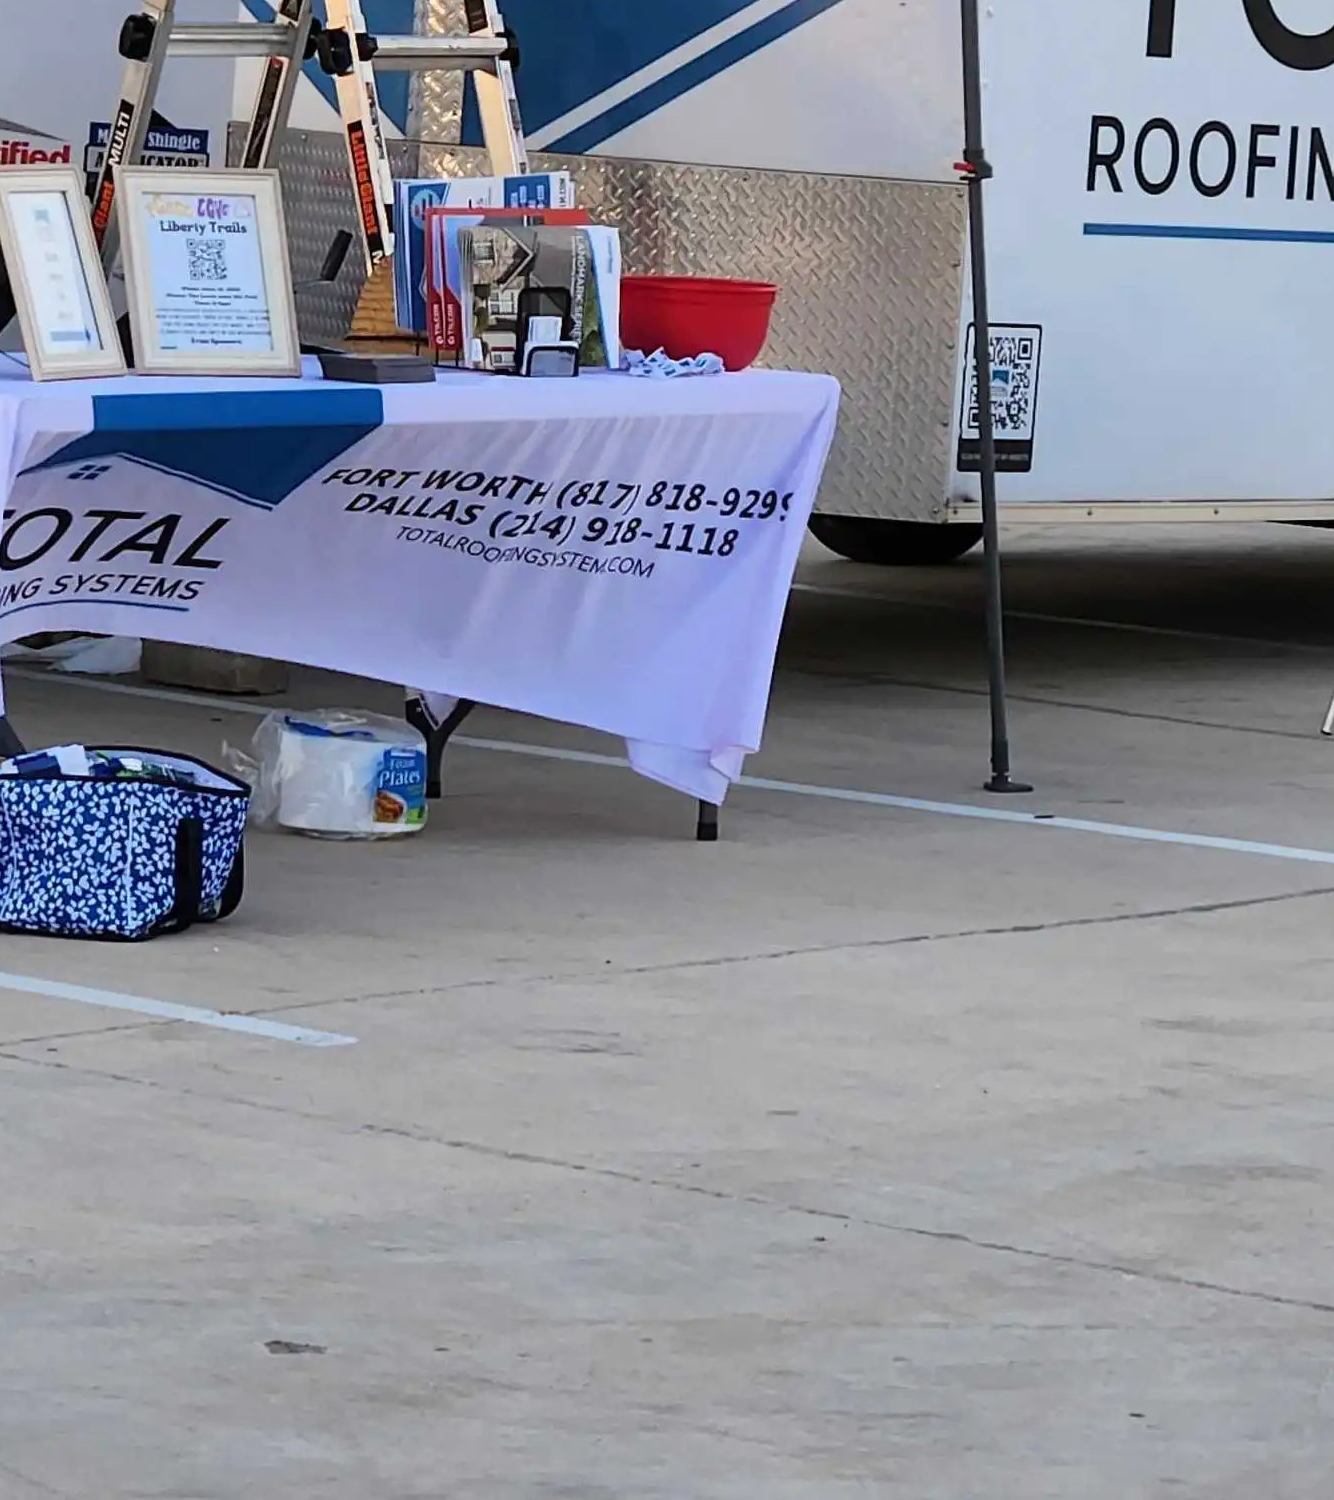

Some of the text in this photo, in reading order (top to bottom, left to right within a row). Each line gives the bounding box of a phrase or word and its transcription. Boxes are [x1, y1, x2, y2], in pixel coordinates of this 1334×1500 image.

[108, 111, 131, 167] MULTI
[147, 131, 201, 151] Shingle
[209, 221, 248, 234] Trails
[322, 468, 420, 489] FORT
[421, 469, 554, 506] WORTH
[556, 480, 642, 515] (817)
[344, 492, 740, 557] DALLAS (214) 918-1118
[48, 574, 206, 601] SYSTEMS
